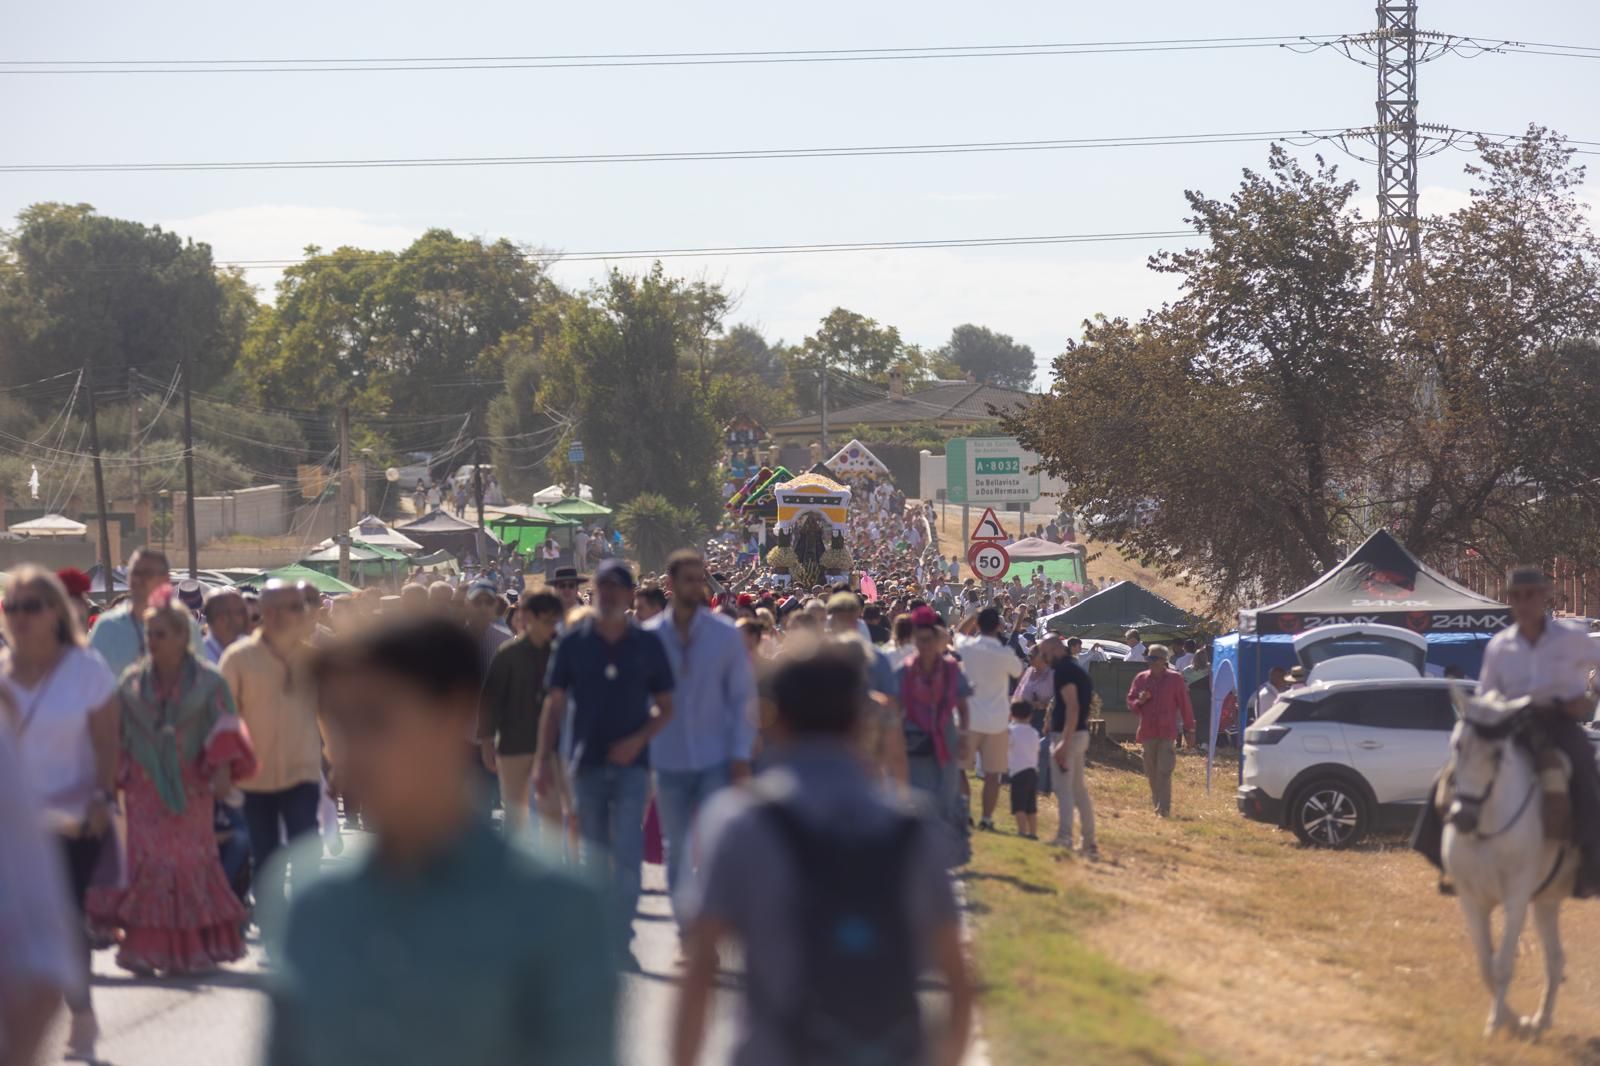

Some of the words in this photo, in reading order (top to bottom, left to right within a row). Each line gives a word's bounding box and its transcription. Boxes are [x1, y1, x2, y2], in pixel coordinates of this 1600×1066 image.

[985, 478, 1020, 486] Bellavista
[980, 487, 994, 495] Dos
[994, 486, 1029, 495] Hermanas
[979, 556, 1000, 569] 50
[1351, 599, 1432, 607] 24MX
[1431, 614, 1508, 628] 24MX
